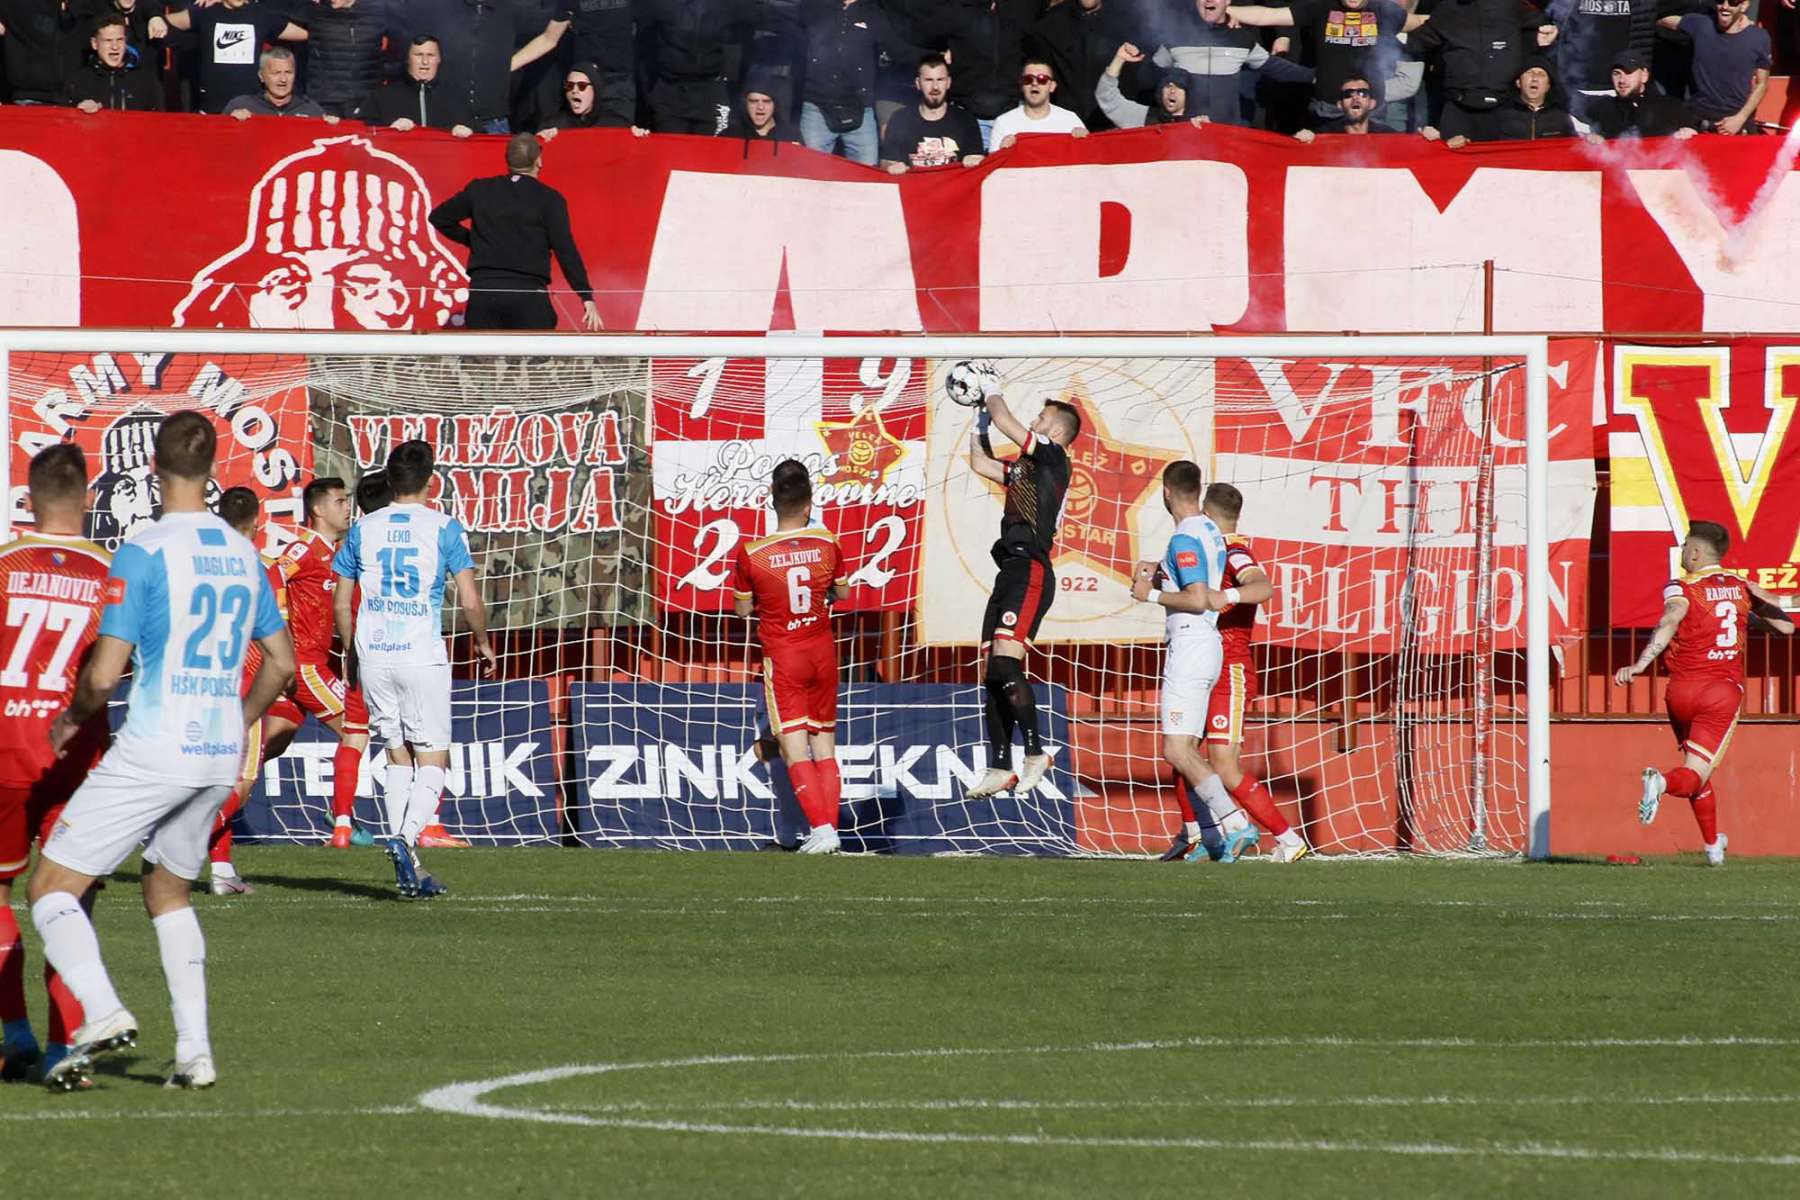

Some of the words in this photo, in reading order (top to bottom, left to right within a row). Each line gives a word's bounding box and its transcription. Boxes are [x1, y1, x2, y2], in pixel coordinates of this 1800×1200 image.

[222, 30, 246, 40] NIKE
[187, 361, 304, 558] MOSTA
[717, 438, 840, 483] Poos
[358, 466, 622, 532] MIJA
[387, 529, 411, 543] LEKO
[676, 518, 741, 591] 2
[847, 515, 907, 589] 2
[1053, 524, 1115, 545] STAR
[192, 555, 247, 577] MAGLICA
[376, 547, 420, 598] 15
[787, 566, 811, 614] 6
[1060, 576, 1099, 592] 922
[1255, 562, 1573, 637] ELIGION
[1715, 600, 1737, 647] 3
[0, 597, 90, 692] 77
[183, 583, 251, 670] 23
[587, 744, 1068, 800] ZINKEKNK
